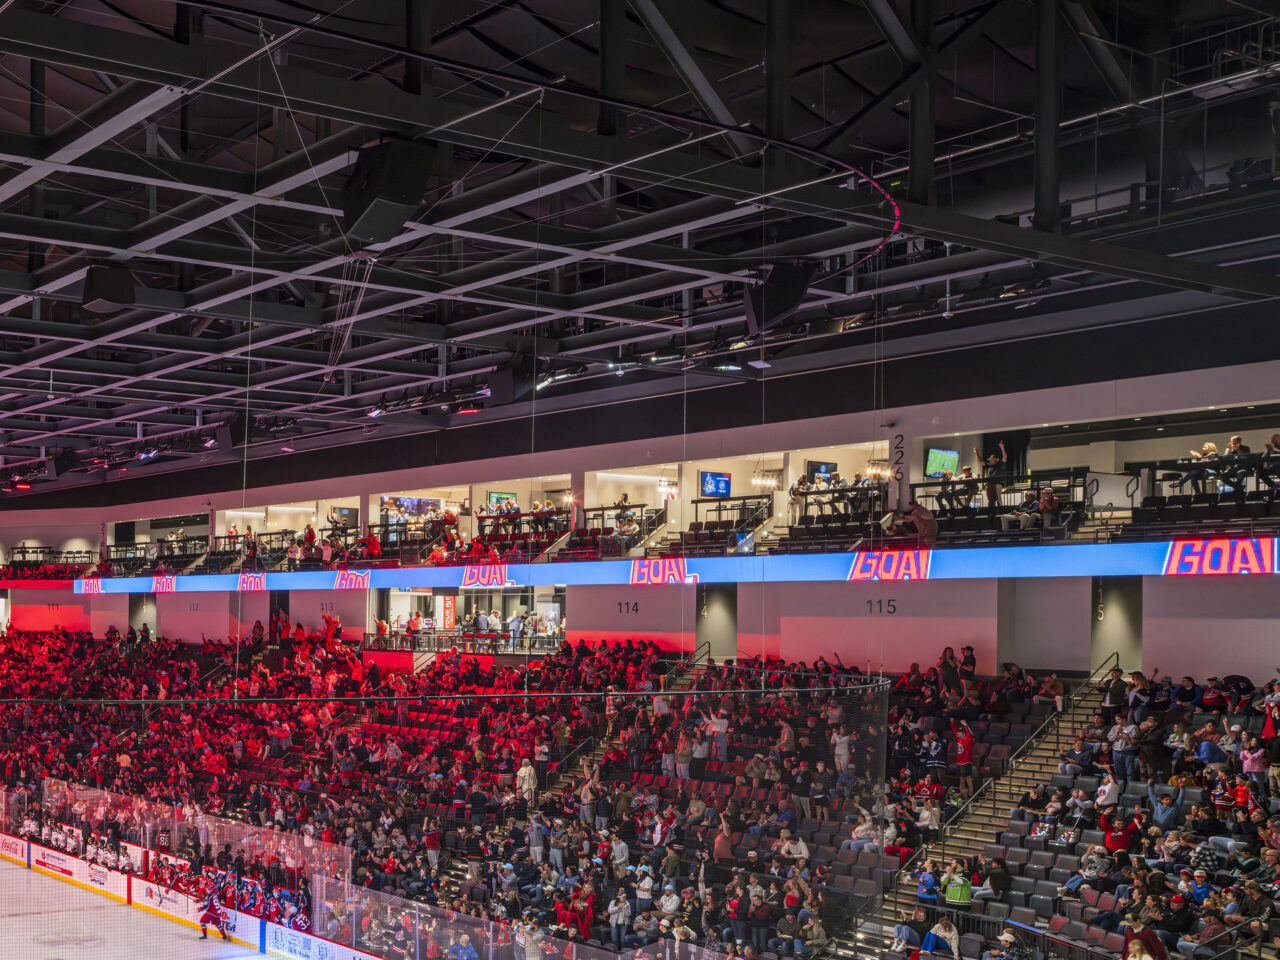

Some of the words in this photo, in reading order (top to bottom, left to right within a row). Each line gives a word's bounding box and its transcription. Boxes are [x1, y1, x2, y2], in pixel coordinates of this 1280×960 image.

[893, 434, 905, 482] 226
[617, 601, 639, 614] 114
[865, 599, 897, 614] 115
